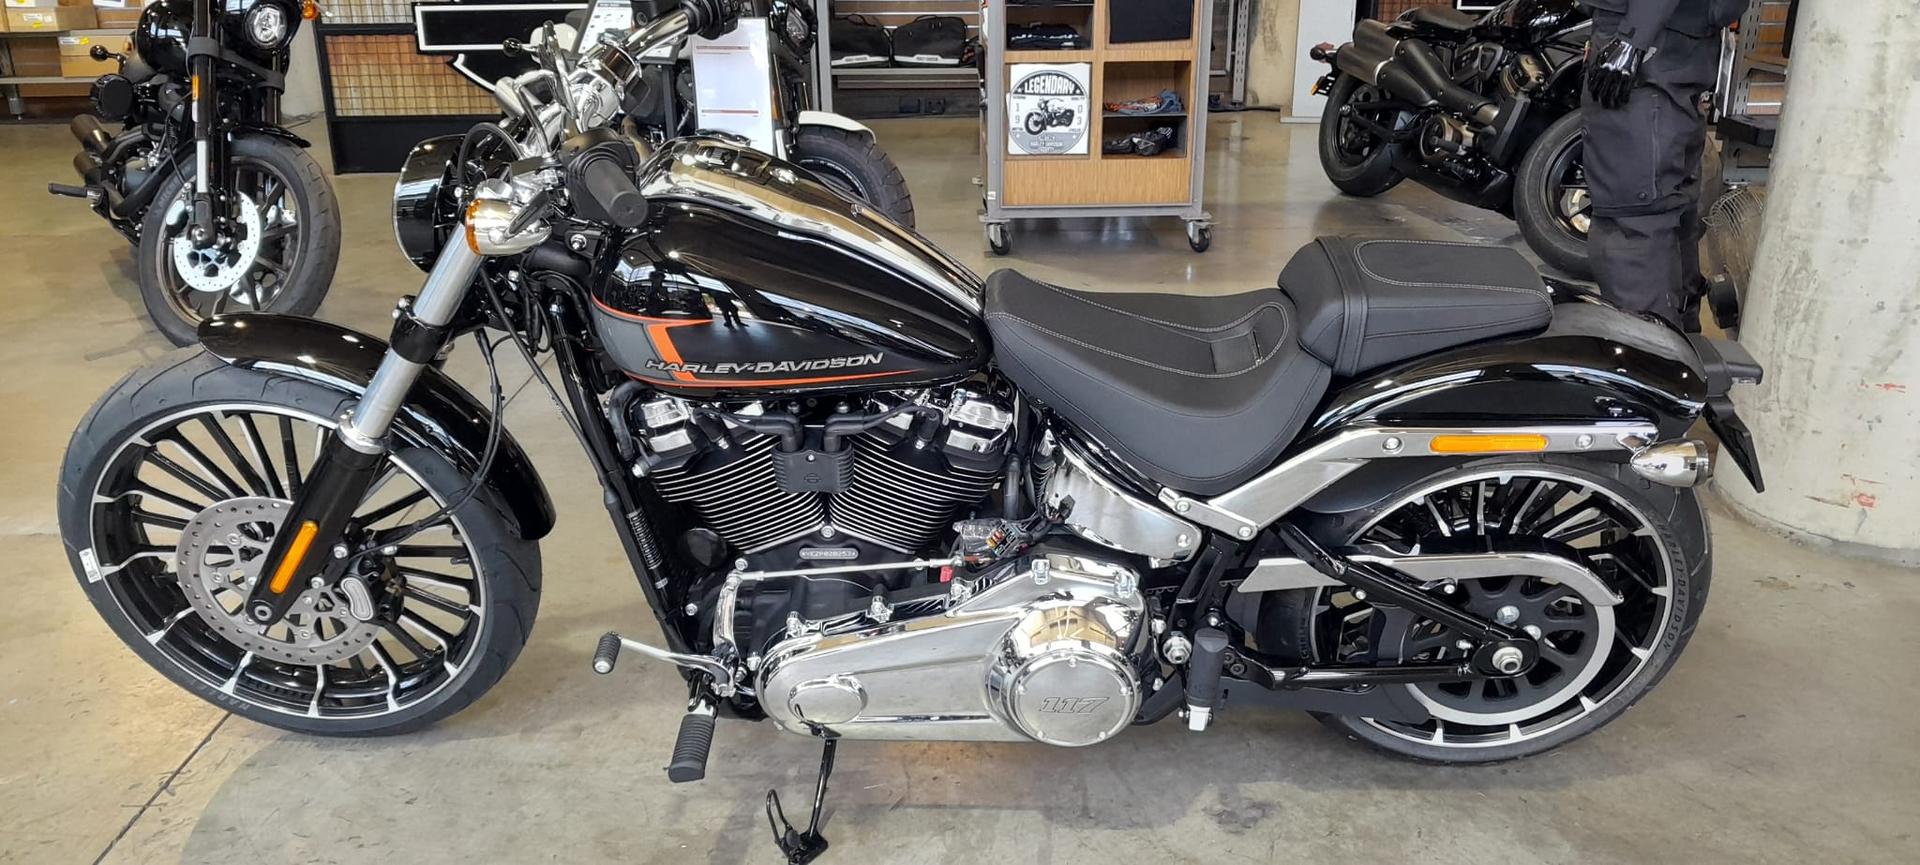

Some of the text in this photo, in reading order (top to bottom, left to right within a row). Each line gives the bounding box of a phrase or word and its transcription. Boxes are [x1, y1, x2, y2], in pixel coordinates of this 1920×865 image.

[1024, 75, 1075, 94] LEGENDARY
[646, 352, 884, 374] HARLEY-DAVIDSON
[1040, 696, 1110, 713] 117
